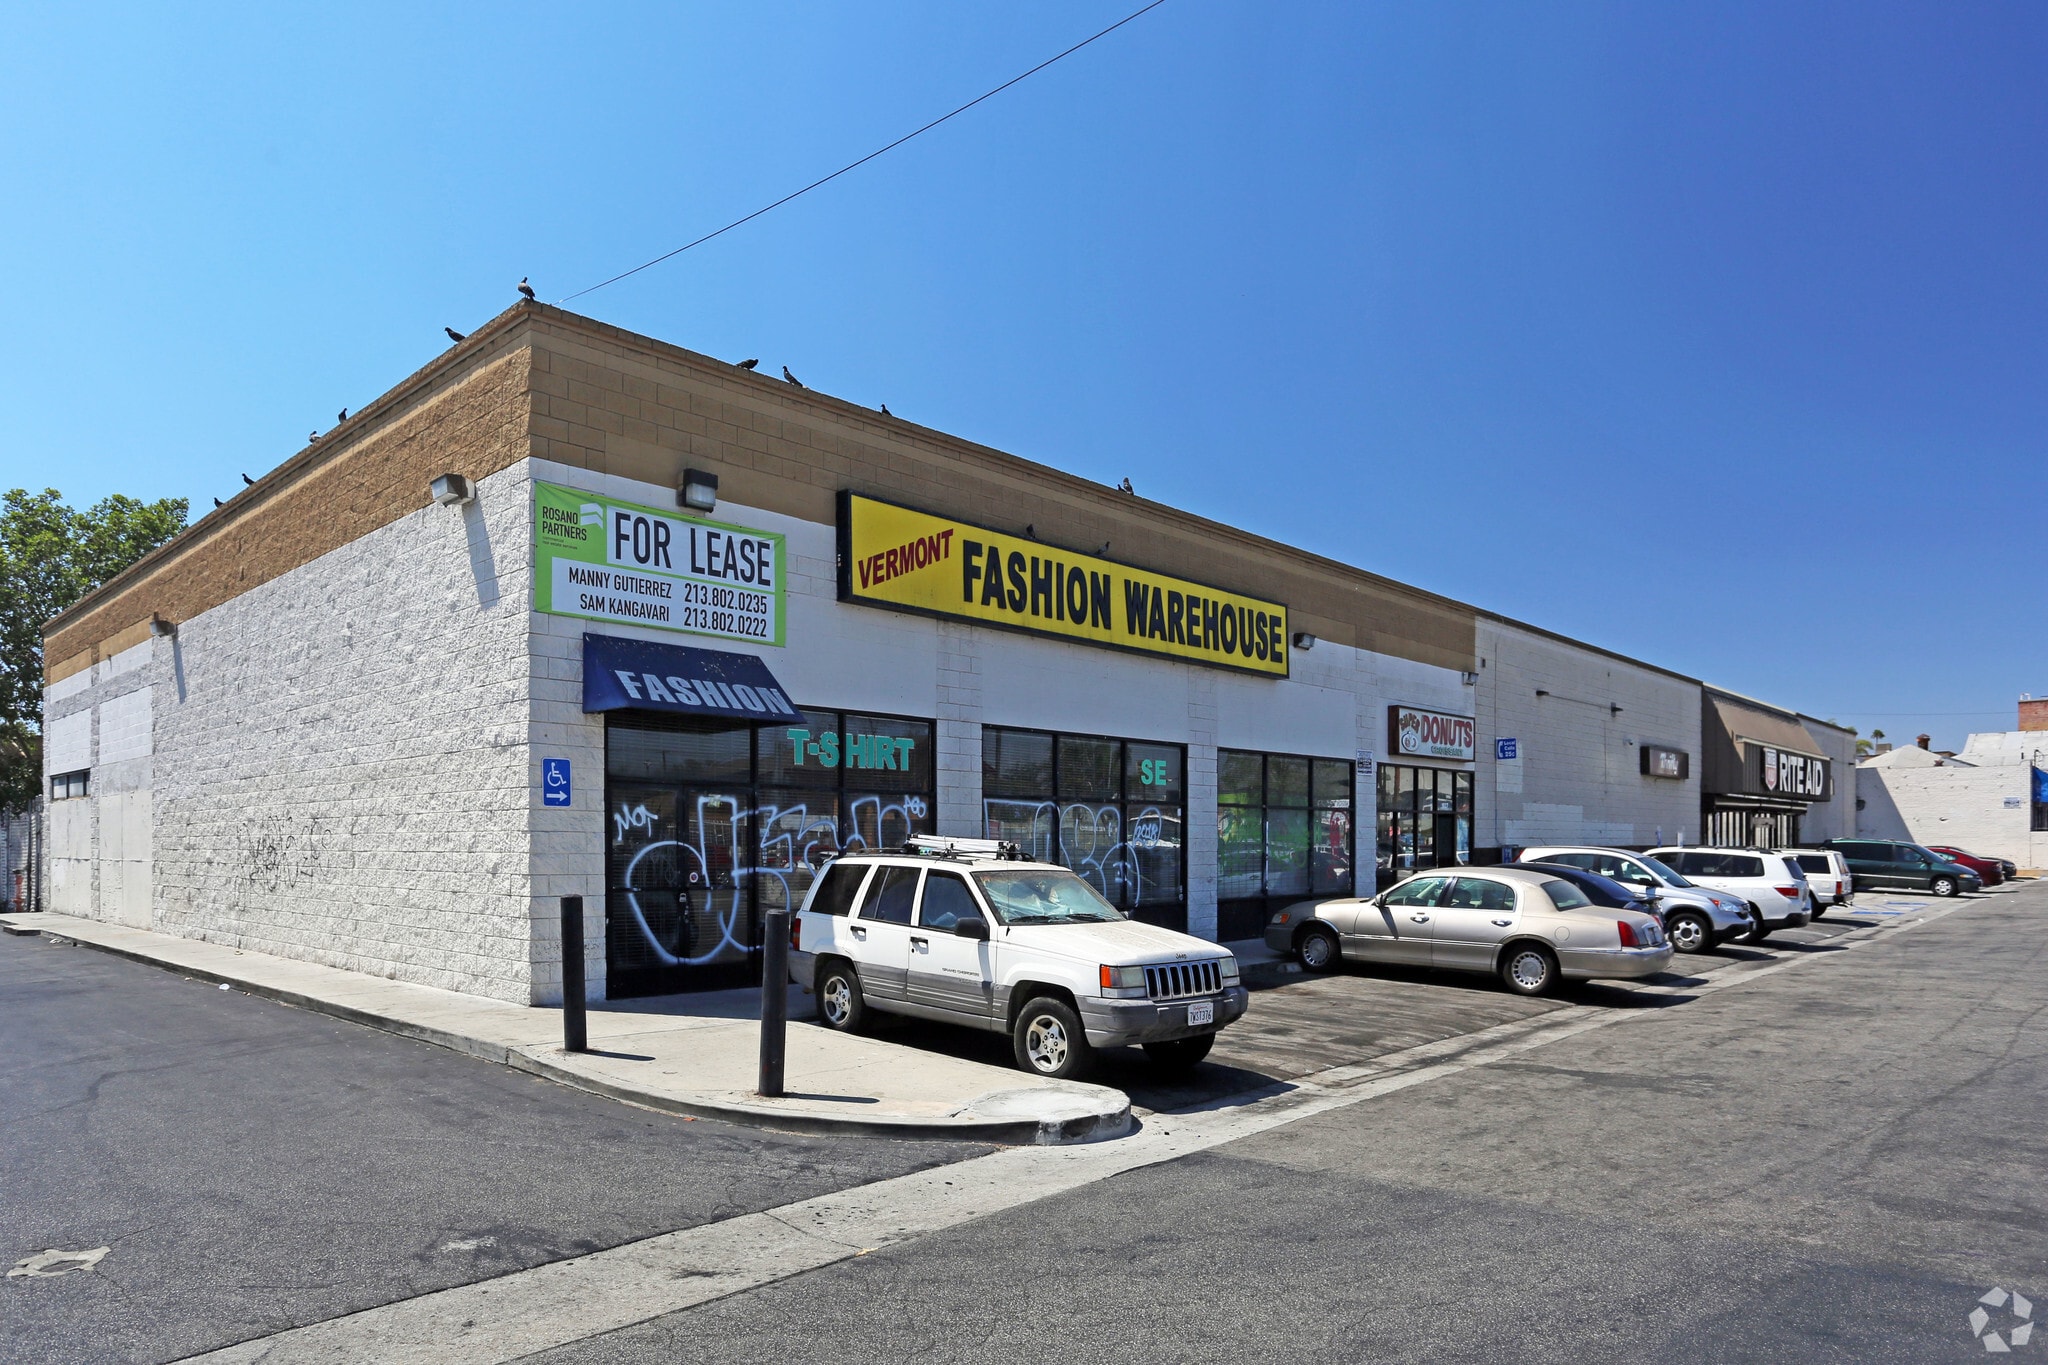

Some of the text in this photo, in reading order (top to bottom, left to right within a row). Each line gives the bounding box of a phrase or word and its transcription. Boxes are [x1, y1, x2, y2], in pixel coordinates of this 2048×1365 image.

[542, 505, 579, 525] ROSANO
[542, 520, 588, 542] PARTNERS
[615, 511, 771, 587] FOR LEASE
[857, 528, 954, 590] VERMONT
[568, 566, 768, 615] MANNY GUTIERREZ 213.802.0235
[962, 538, 1284, 665] FASHION WAREHOUSE
[579, 593, 767, 638] SAM KANGAVARI 213.802.0222
[614, 669, 795, 716] FASHION
[1421, 714, 1473, 749] DONUTS
[1140, 758, 1168, 786] SE
[1779, 753, 1824, 796] RITE AID
